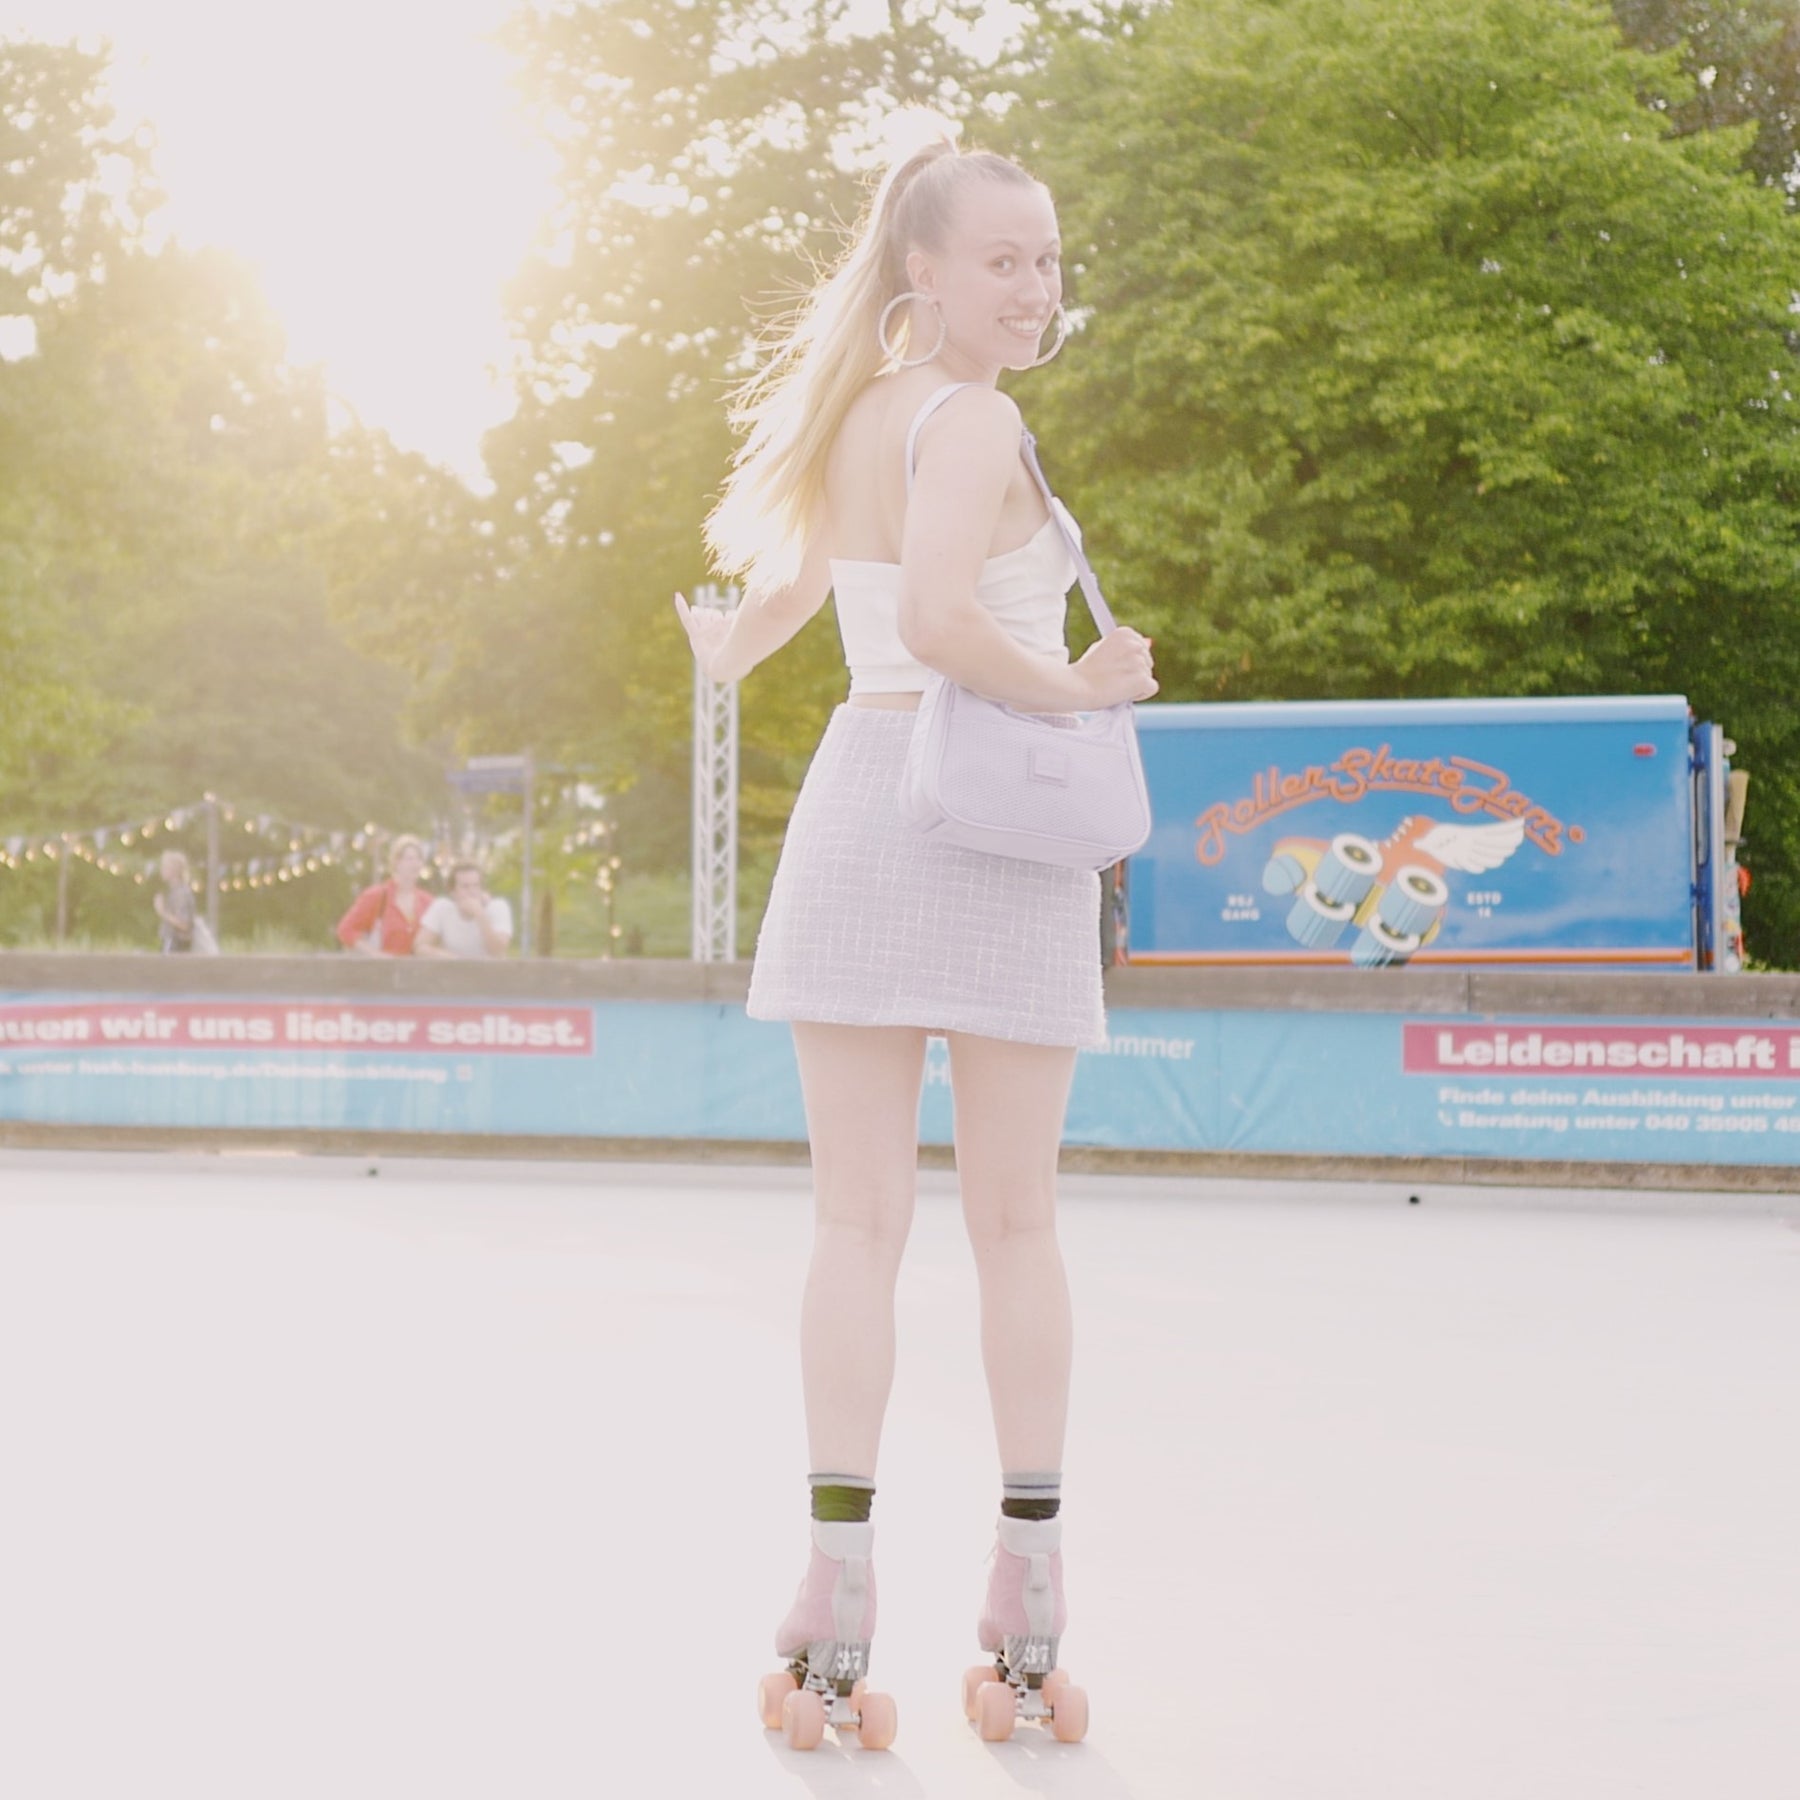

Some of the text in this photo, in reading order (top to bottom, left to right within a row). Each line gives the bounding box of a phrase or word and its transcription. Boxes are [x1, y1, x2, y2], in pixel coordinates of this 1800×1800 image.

[1196, 766, 1332, 866] Roller
[1329, 743, 1466, 803] Skate
[1221, 908, 1261, 922] GANG
[101, 1010, 178, 1039] wir
[189, 1017, 275, 1041] uns
[285, 1011, 416, 1043] lieber
[427, 1014, 586, 1047] selbst.
[1437, 1032, 1776, 1069] Leidenschaft
[1438, 1087, 1797, 1111] Finde deine Ausbildung unter
[1458, 1110, 1569, 1132] Beratung
[1575, 1114, 1640, 1130] unter
[1645, 1114, 1689, 1131] 040
[837, 1651, 862, 1670] 37
